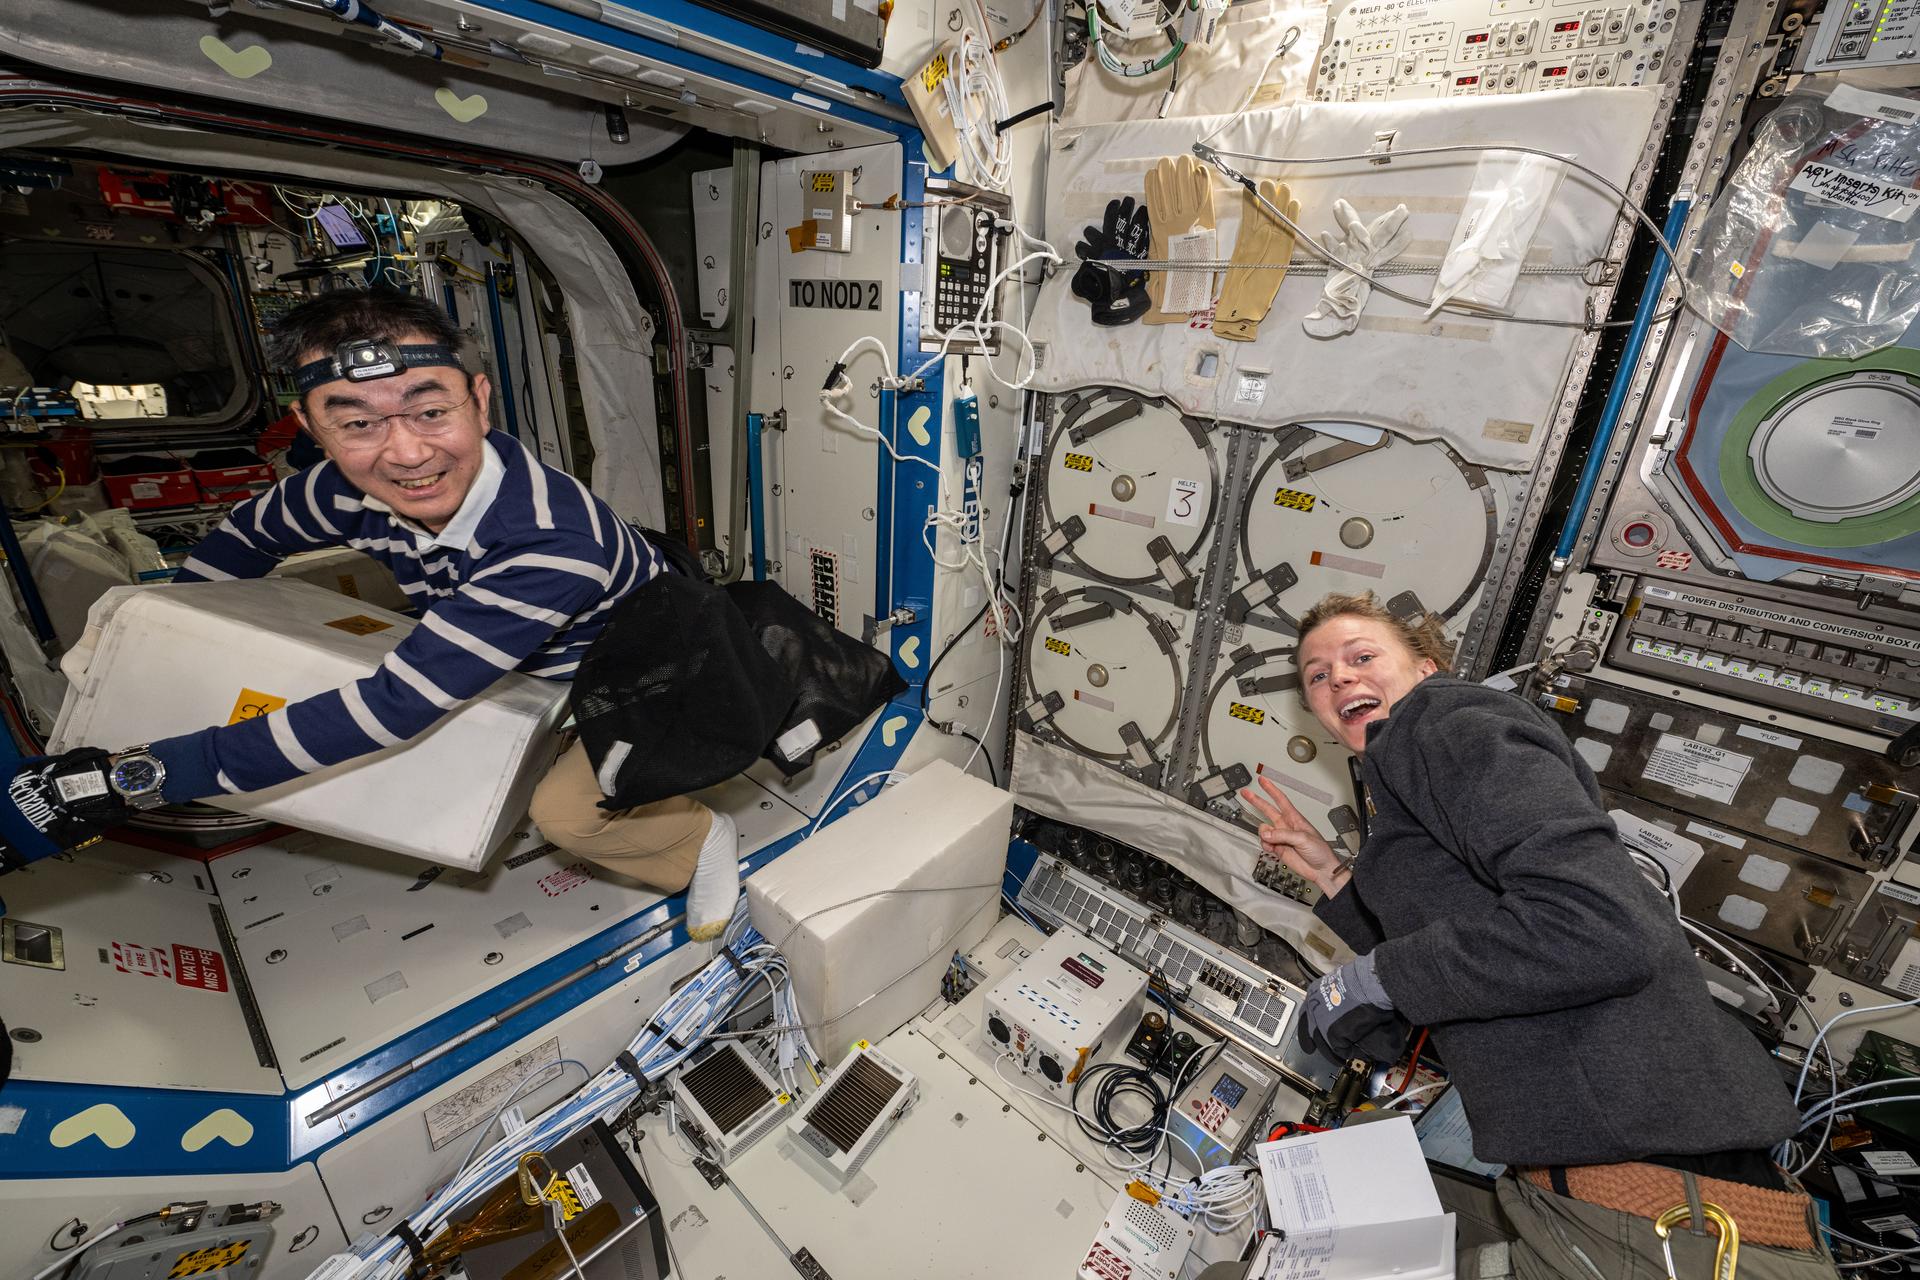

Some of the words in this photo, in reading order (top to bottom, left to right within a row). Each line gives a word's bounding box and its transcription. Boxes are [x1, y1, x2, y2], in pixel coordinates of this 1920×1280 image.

[1360, 6, 1381, 15] MELFI
[792, 281, 815, 307] TO
[821, 282, 862, 309] NOD
[868, 283, 879, 310] 2
[1177, 480, 1197, 489] MELFI
[1174, 488, 1196, 518] 3
[1682, 594, 1717, 607] POWER
[1718, 602, 1787, 622] DISTRIBUTION
[1788, 617, 1811, 627] AND
[1812, 622, 1884, 642] CONVERSION
[1886, 636, 1913, 648] BOX
[1777, 682, 1798, 690] AIRLOCK
[1683, 741, 1726, 758] LAB1S2_G1
[1639, 828, 1673, 848] LAB1S2_H1
[135, 952, 148, 967] FIRE
[180, 948, 198, 980] WATER
[198, 949, 213, 966] PFE
[204, 967, 219, 990] MIST
[188, 1251, 220, 1261] WARNING
[1095, 1254, 1110, 1266] PORT
[1109, 1265, 1123, 1278] FIRE
